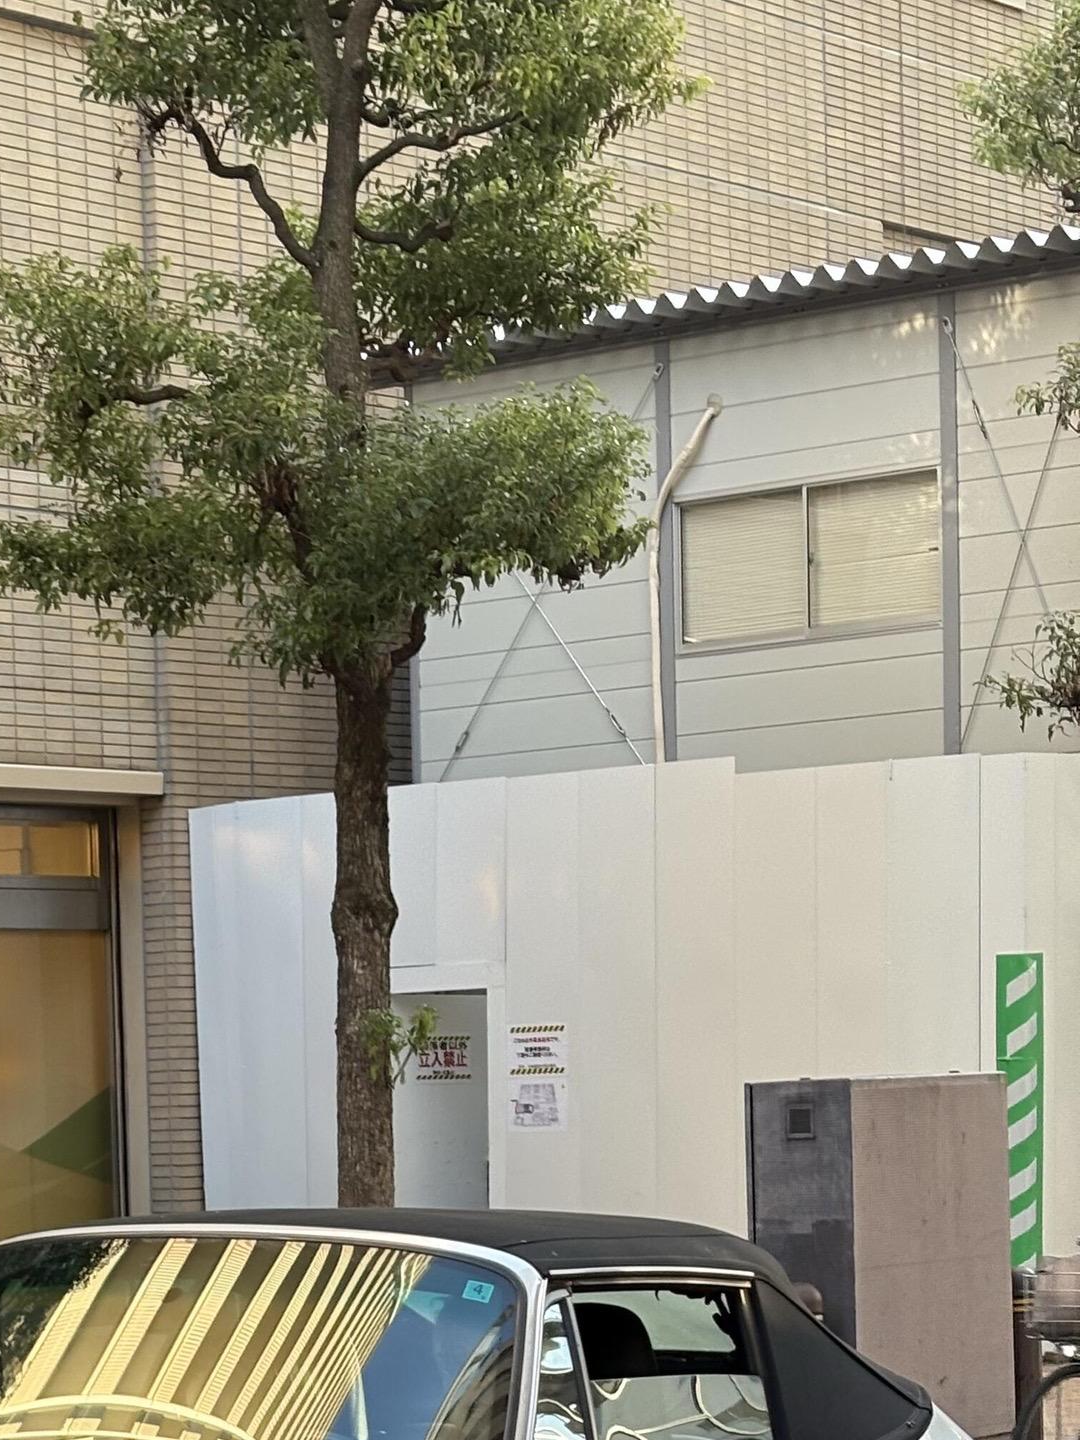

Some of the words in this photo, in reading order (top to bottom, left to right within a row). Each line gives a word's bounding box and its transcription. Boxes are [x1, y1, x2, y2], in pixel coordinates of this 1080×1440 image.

[419, 1051, 468, 1068] 立入禁止
[473, 1284, 484, 1296] 4
